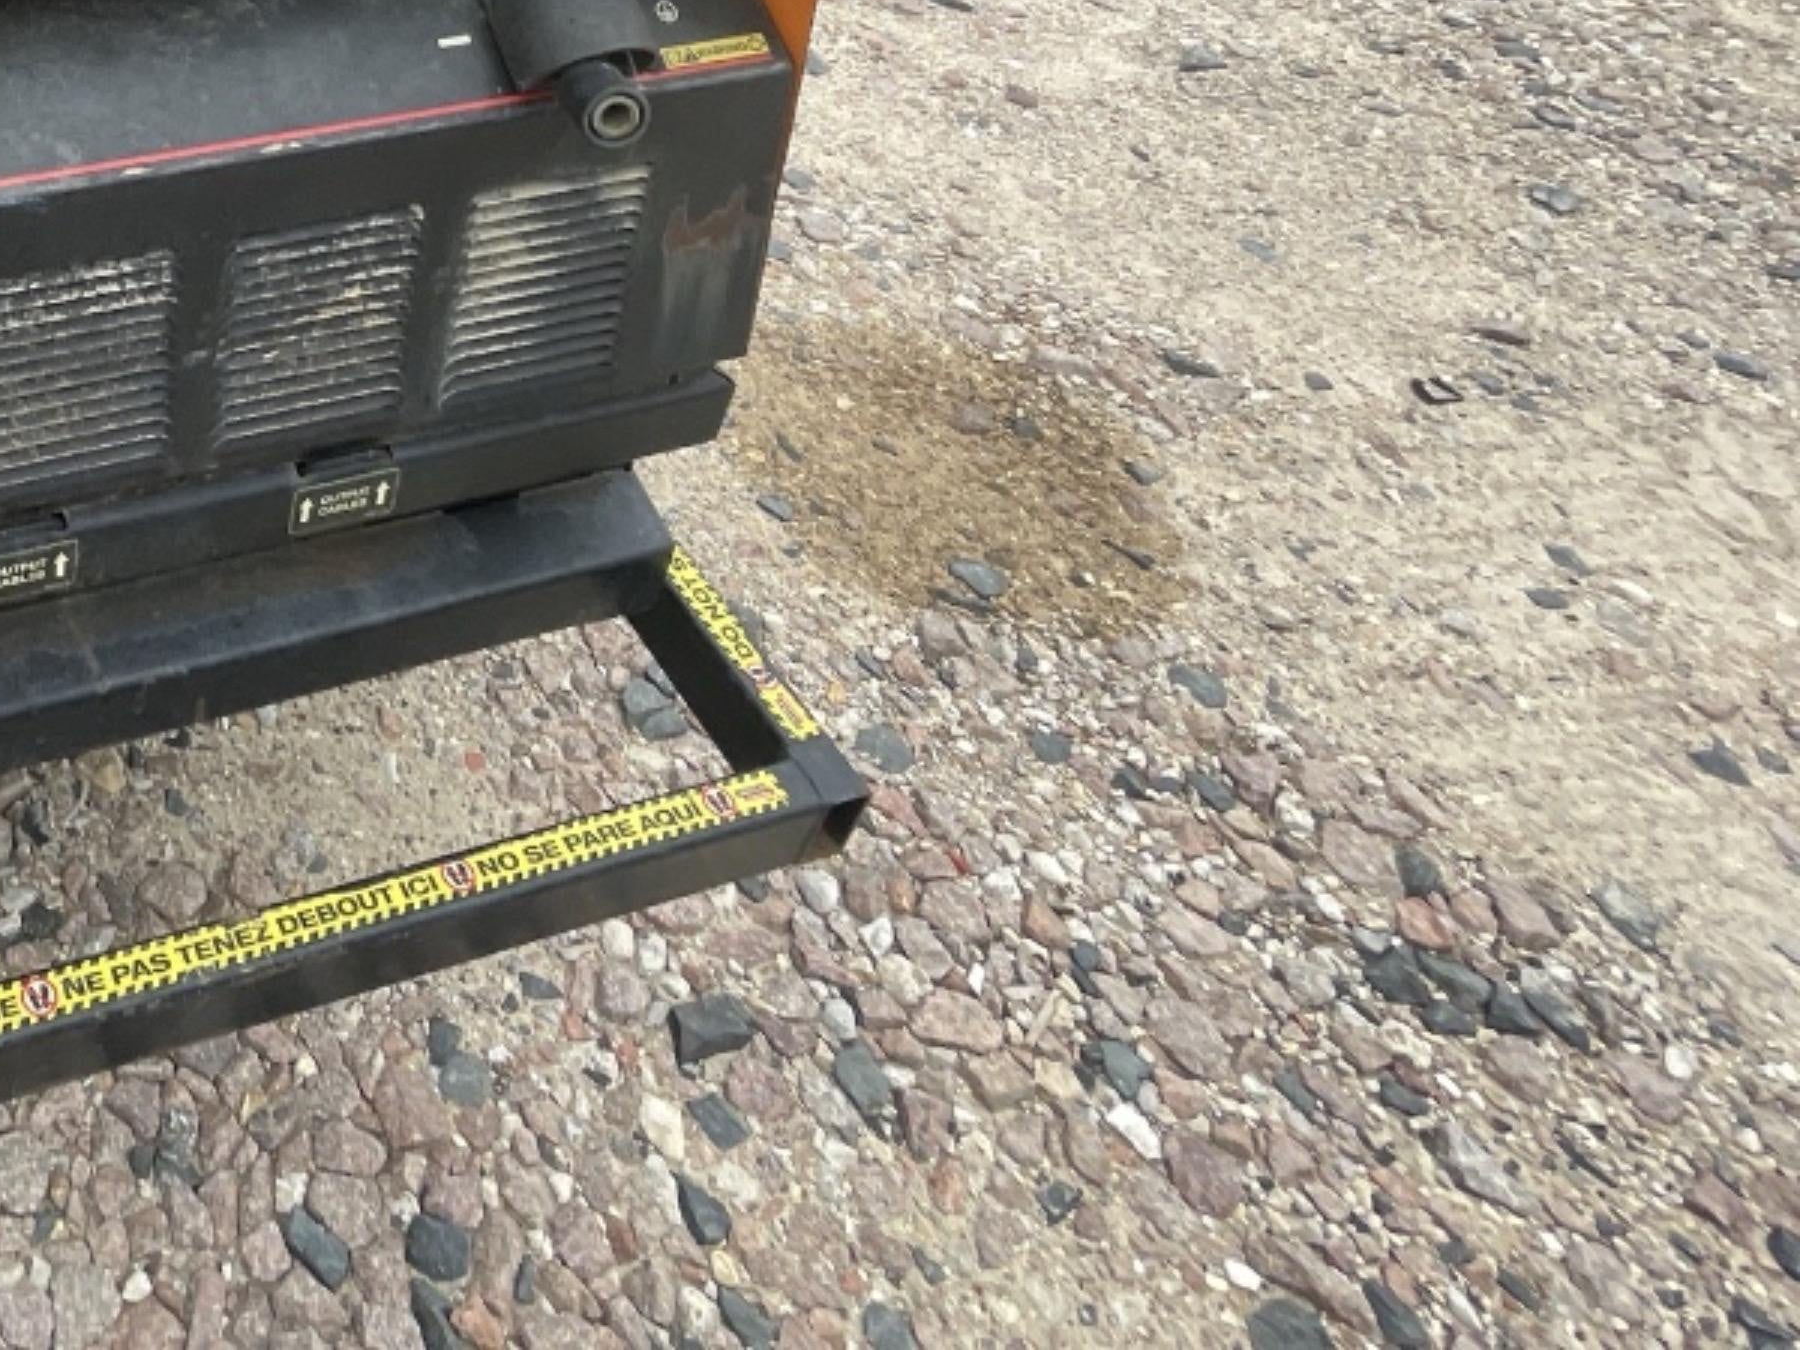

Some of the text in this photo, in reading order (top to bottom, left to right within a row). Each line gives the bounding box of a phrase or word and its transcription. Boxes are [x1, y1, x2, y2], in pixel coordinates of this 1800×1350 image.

[317, 495, 369, 518] CABLES
[320, 485, 371, 507] OUTPUT
[61, 971, 104, 1000] NE
[111, 952, 173, 986] PAS
[176, 922, 271, 966] TENEZ
[275, 890, 396, 936] DEBOUT
[399, 872, 440, 898] ICI
[476, 851, 521, 878] NO
[521, 840, 561, 866] SE
[566, 819, 636, 853] PARE
